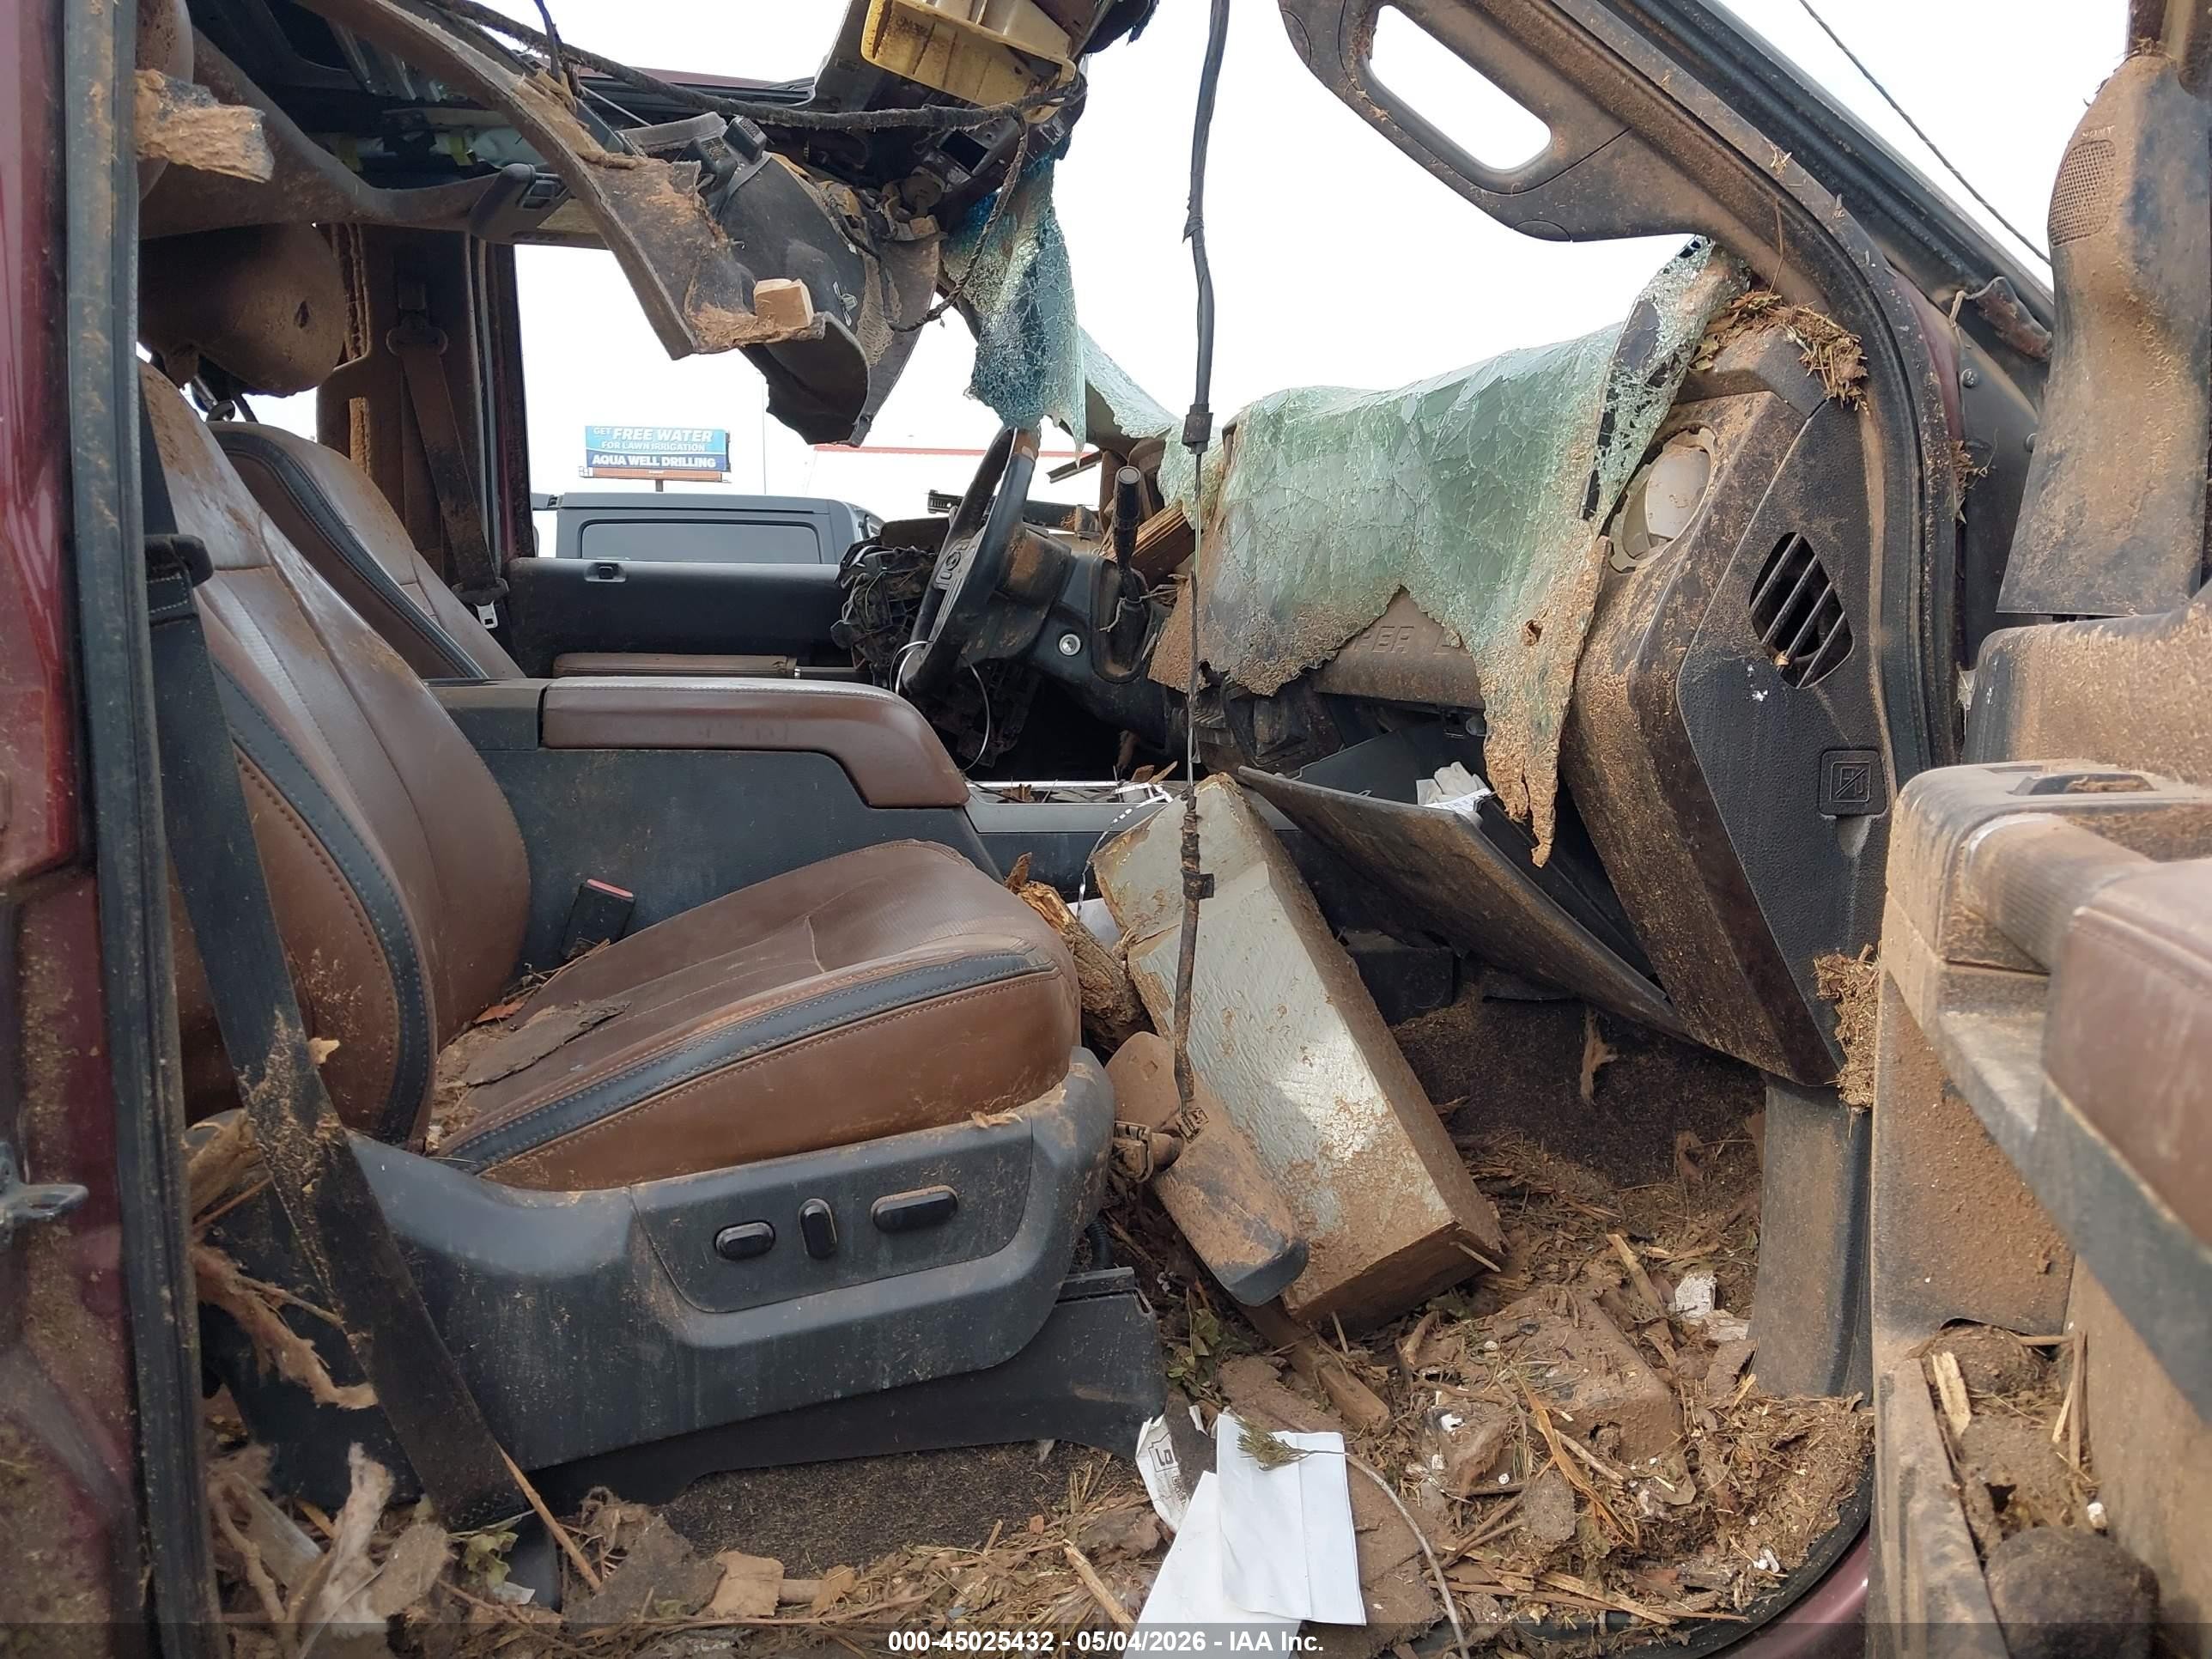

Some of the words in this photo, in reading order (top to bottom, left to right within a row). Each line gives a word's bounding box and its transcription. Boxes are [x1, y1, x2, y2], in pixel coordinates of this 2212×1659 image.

[593, 427, 612, 435] GET
[612, 428, 653, 441] FREE
[658, 428, 714, 443] WATER
[602, 441, 621, 450] FOR
[623, 441, 649, 451] LAWN
[651, 442, 706, 453] IRRIGATION
[592, 454, 627, 465] AQUA
[627, 456, 659, 466] WELL
[661, 457, 716, 468] DRILLING
